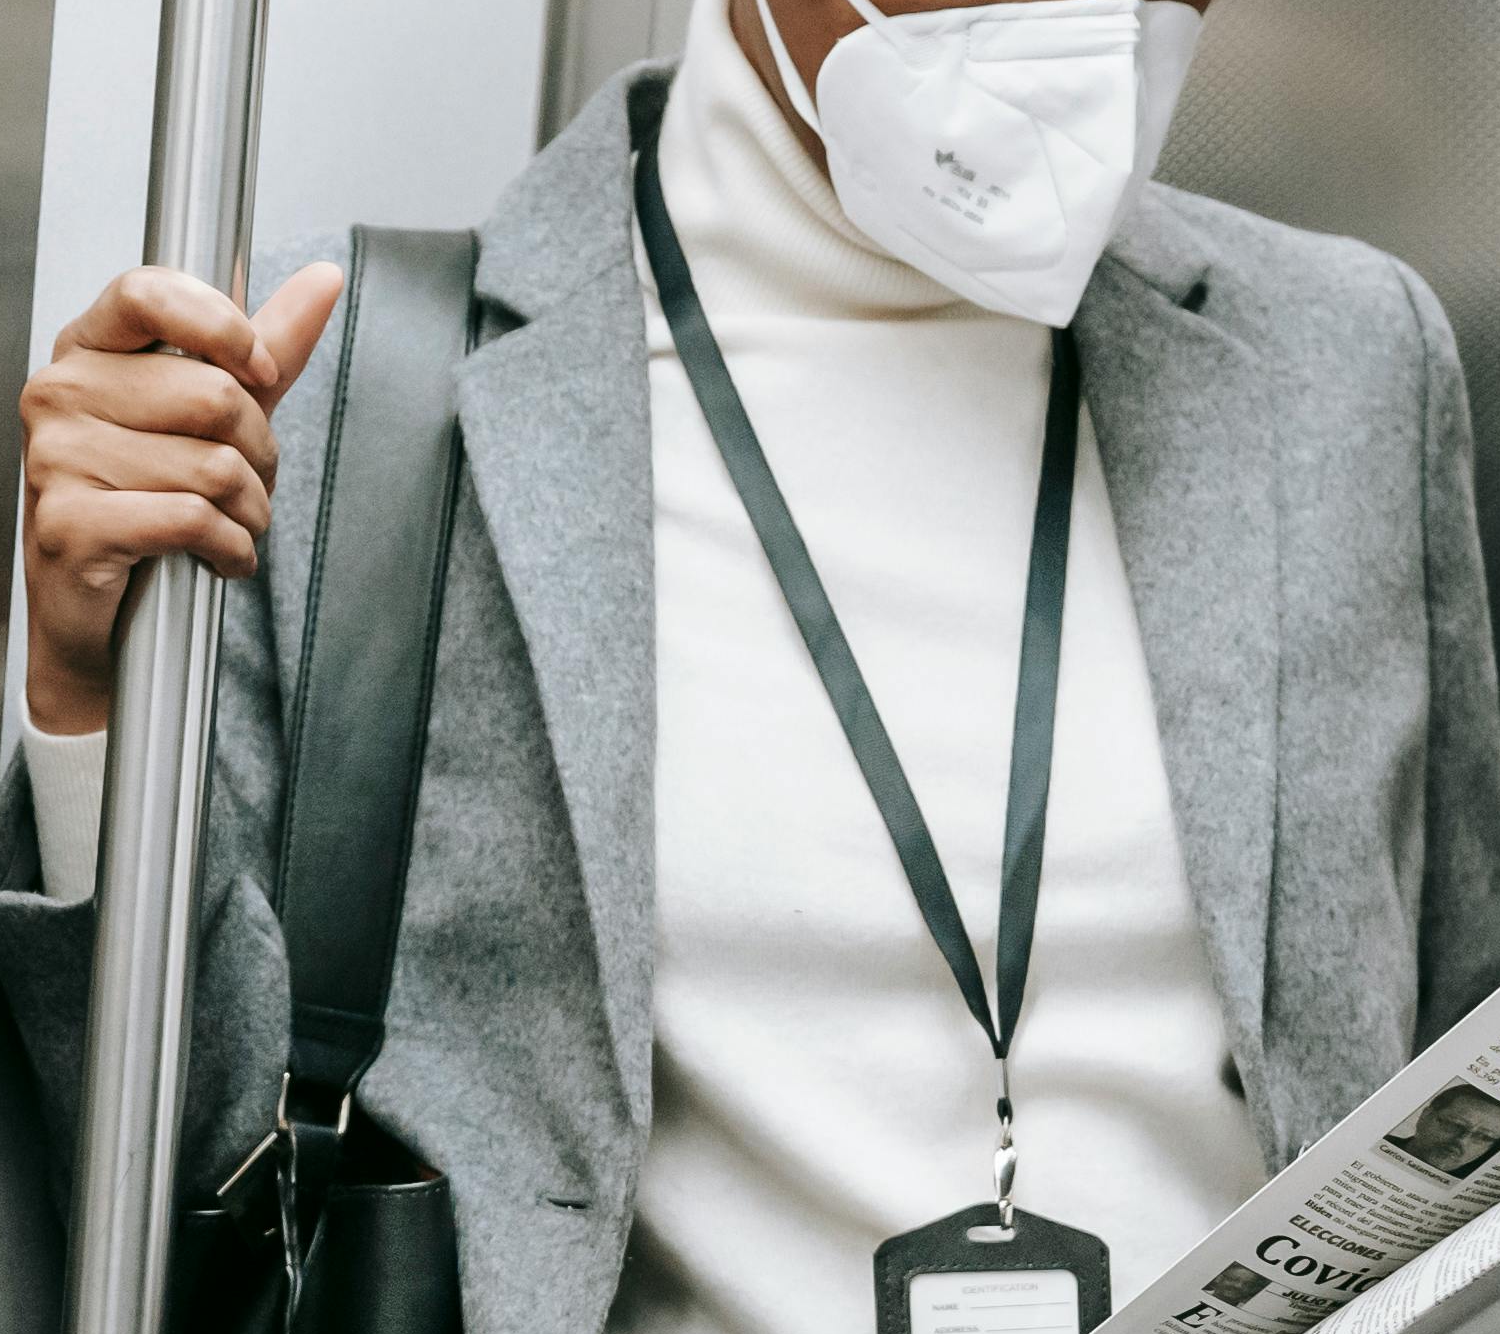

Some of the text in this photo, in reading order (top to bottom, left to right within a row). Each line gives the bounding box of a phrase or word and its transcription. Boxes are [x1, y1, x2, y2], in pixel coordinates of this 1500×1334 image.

[1305, 1199, 1332, 1219] Biden
[1289, 1215, 1387, 1261] ELECCIONES
[963, 1283, 1038, 1294] IDENTIFICATION
